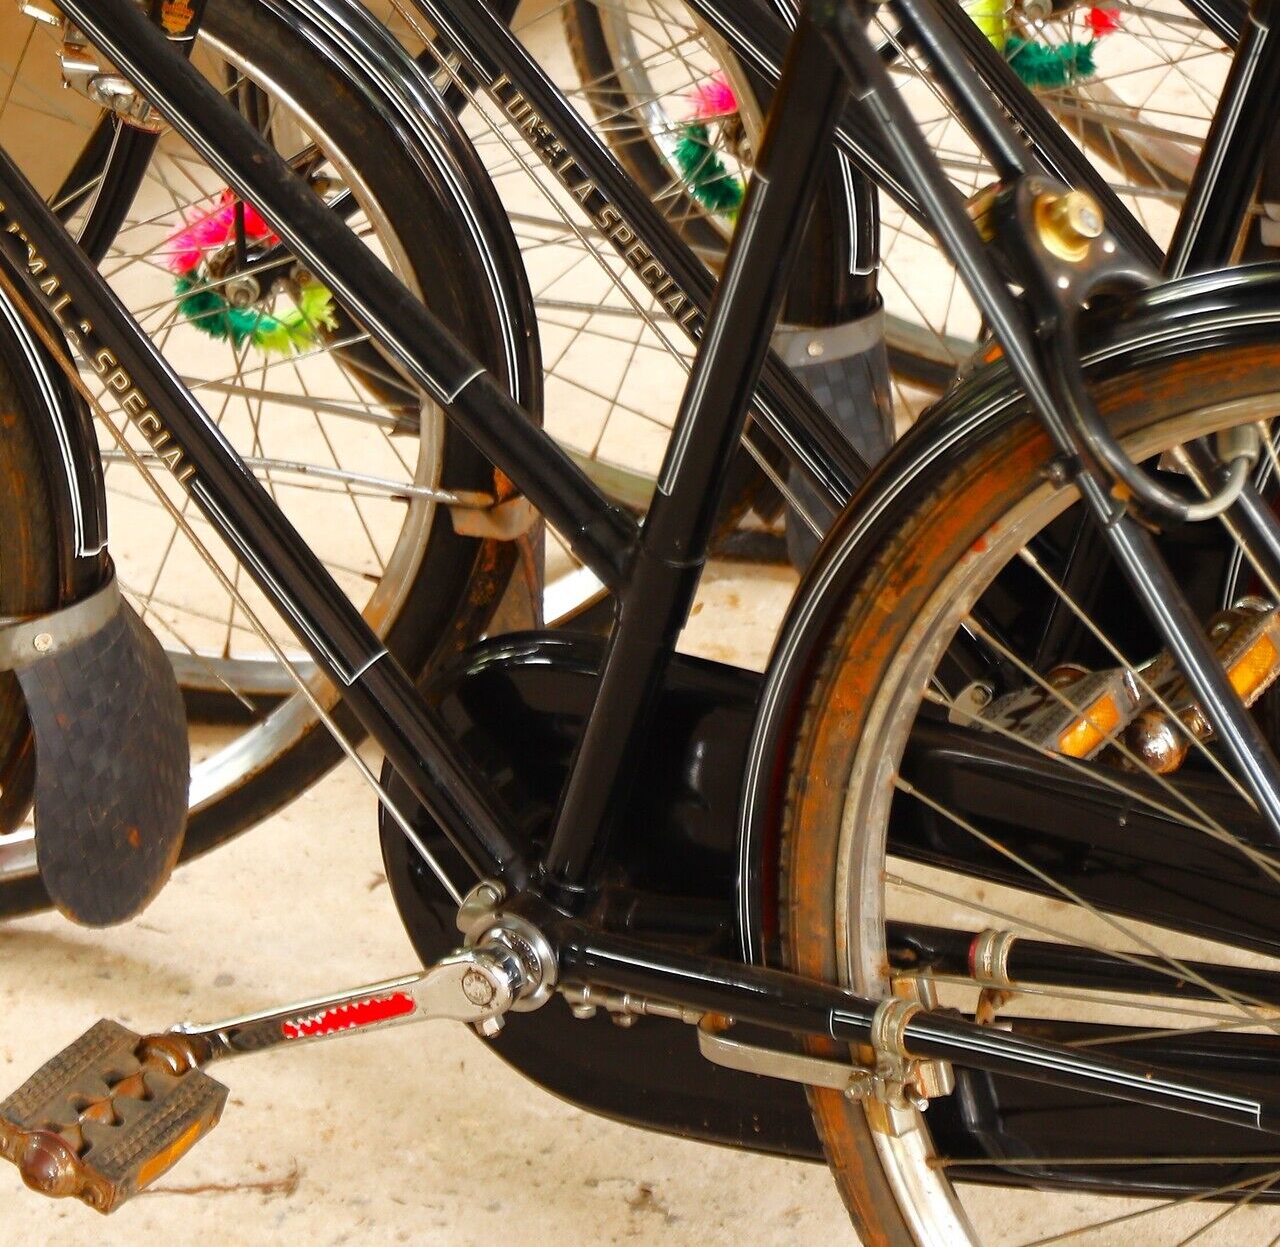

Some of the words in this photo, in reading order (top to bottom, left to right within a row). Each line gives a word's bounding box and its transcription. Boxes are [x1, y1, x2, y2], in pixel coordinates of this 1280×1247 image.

[491, 75, 596, 203] LUMALA
[596, 208, 698, 332] SPECIAL
[94, 349, 197, 486] SPECIAL
